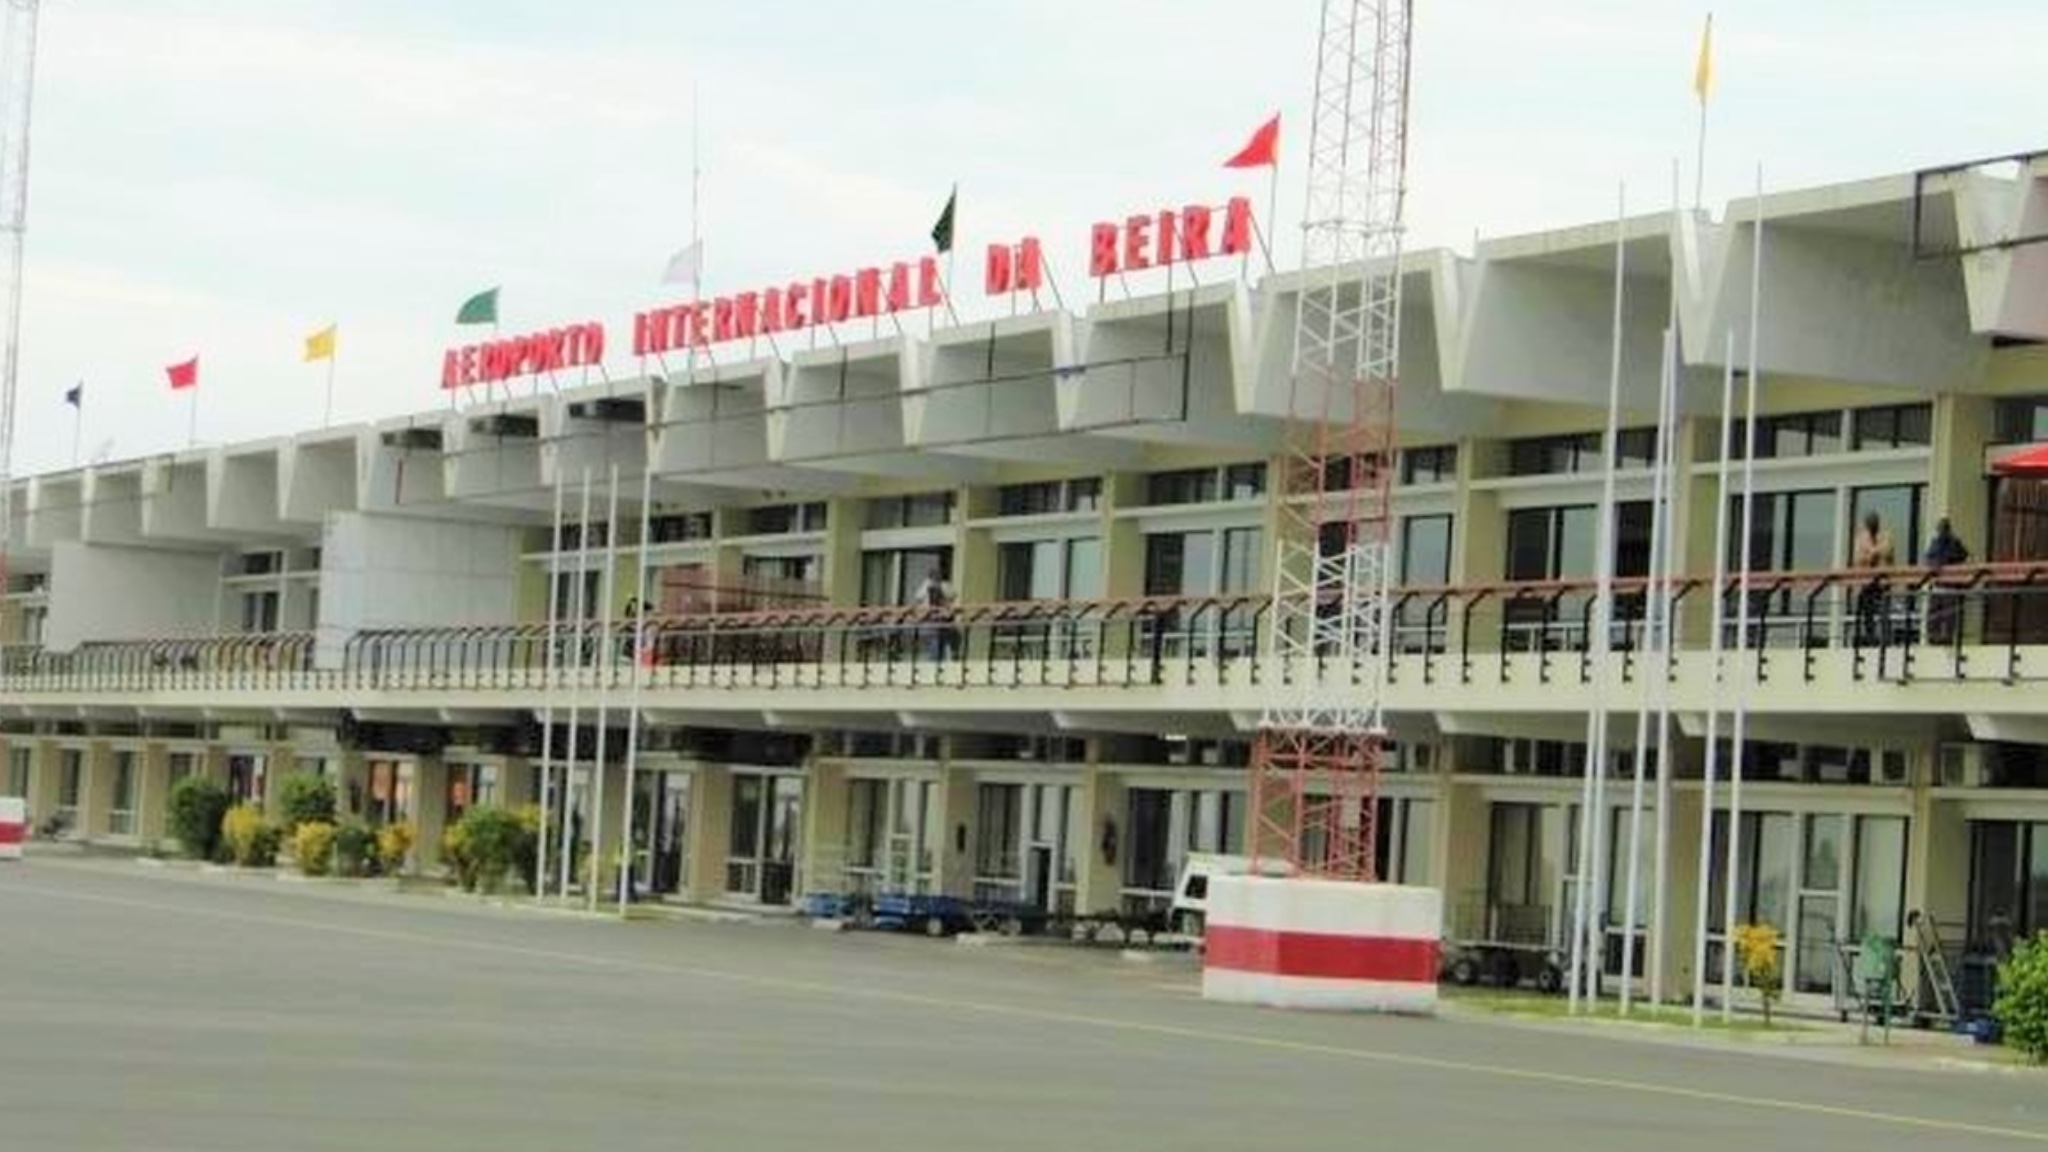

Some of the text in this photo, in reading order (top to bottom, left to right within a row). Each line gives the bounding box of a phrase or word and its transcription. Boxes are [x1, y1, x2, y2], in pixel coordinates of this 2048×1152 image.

[441, 196, 1252, 389] AEROPORTO INTERNACIONAL DA BEIRA
